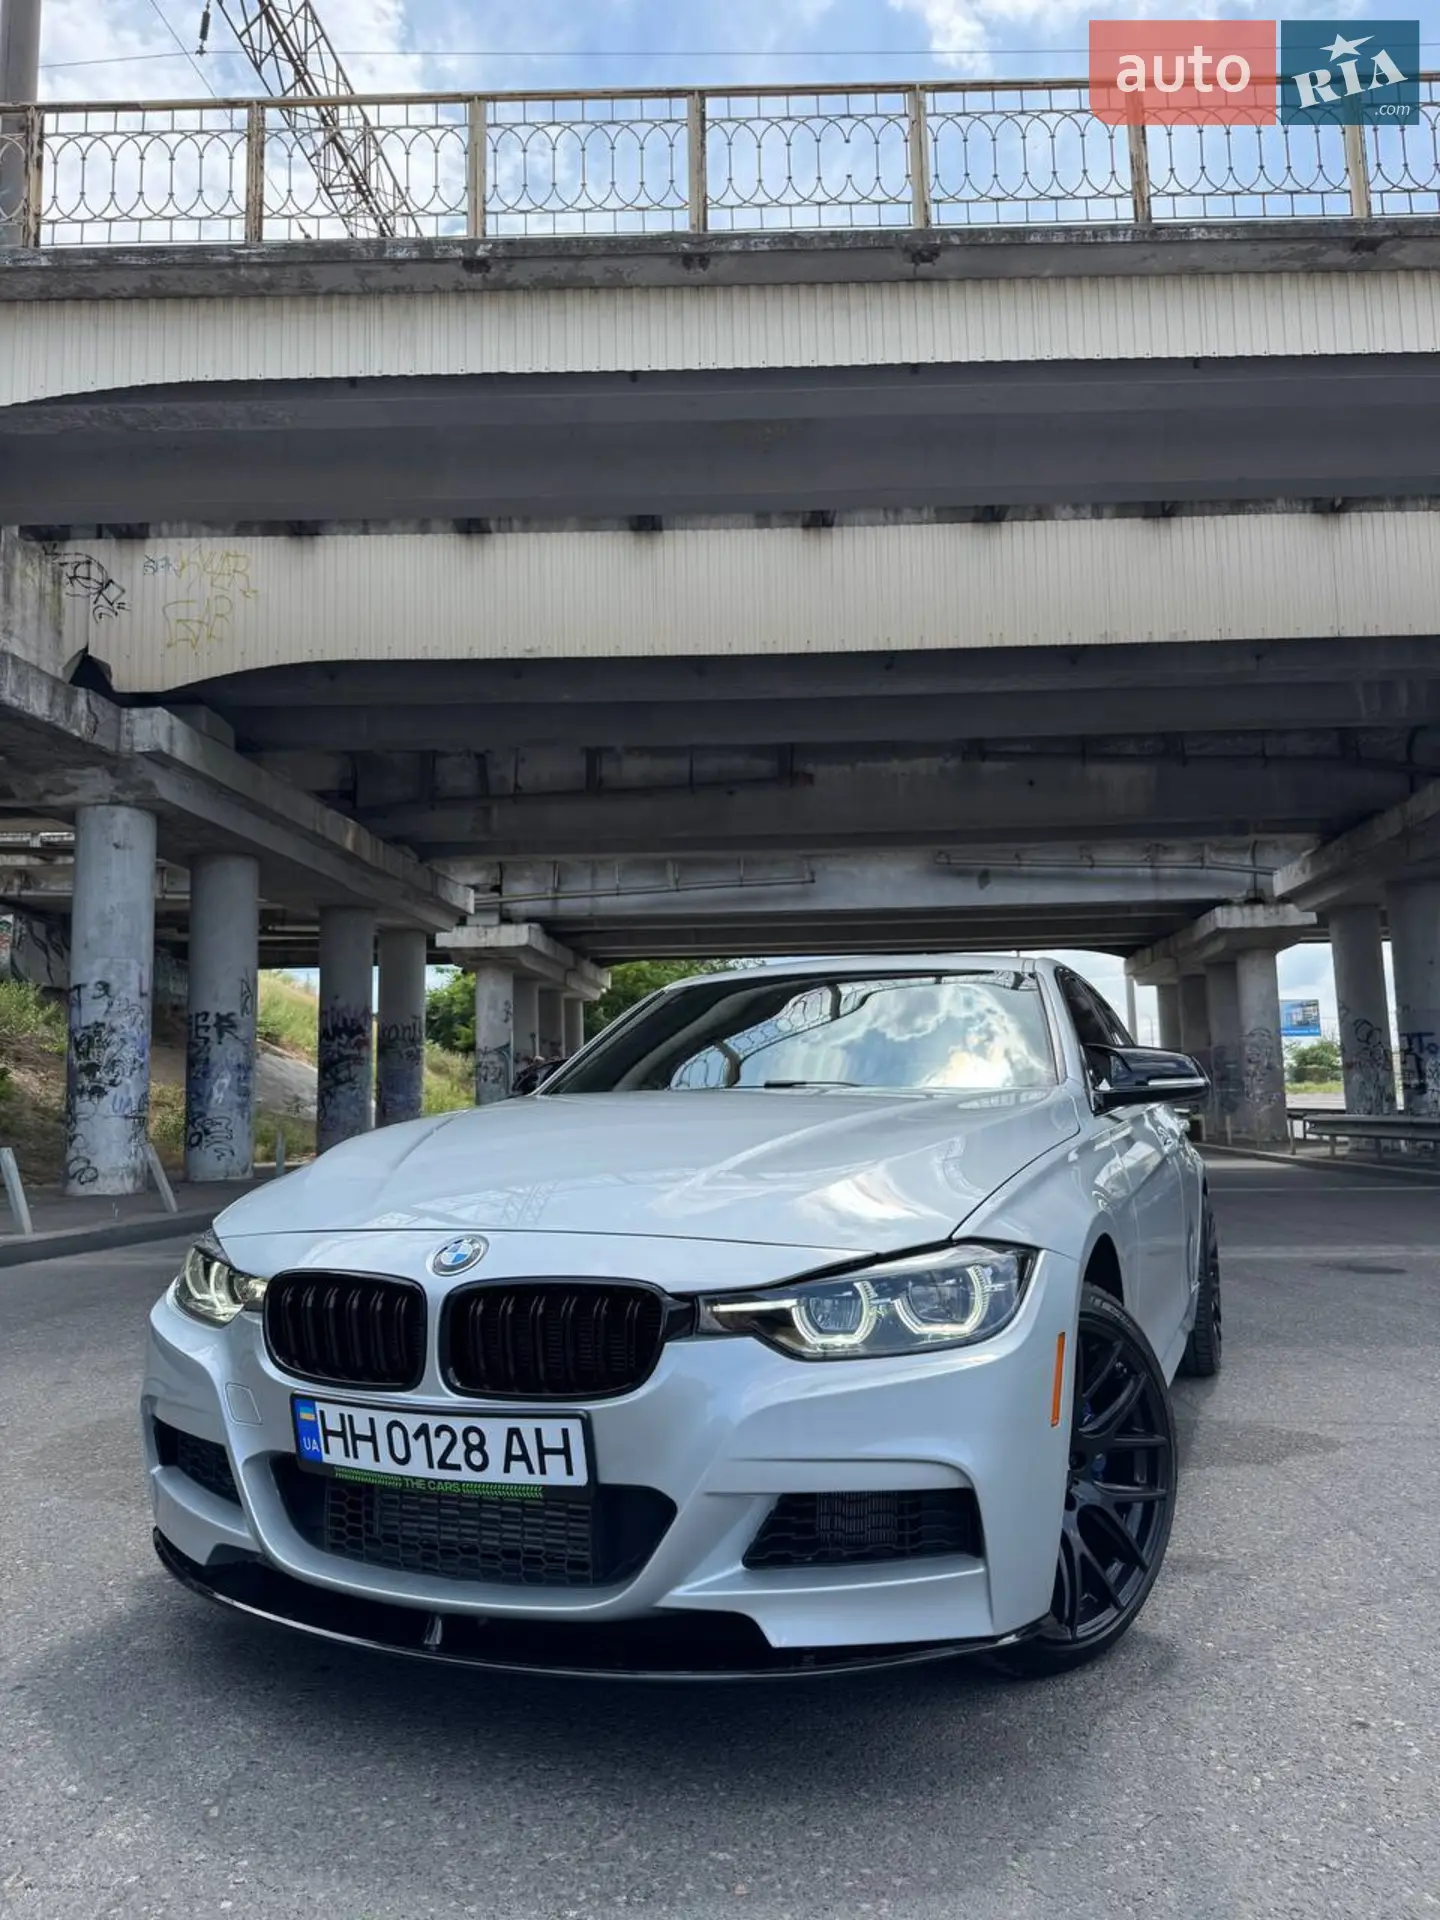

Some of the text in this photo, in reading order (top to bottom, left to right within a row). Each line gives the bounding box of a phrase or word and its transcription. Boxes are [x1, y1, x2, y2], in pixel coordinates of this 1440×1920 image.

[302, 1436, 320, 1452] UA
[319, 1409, 574, 1476] HH 0128 AH
[404, 1478, 462, 1493] THE CARS
